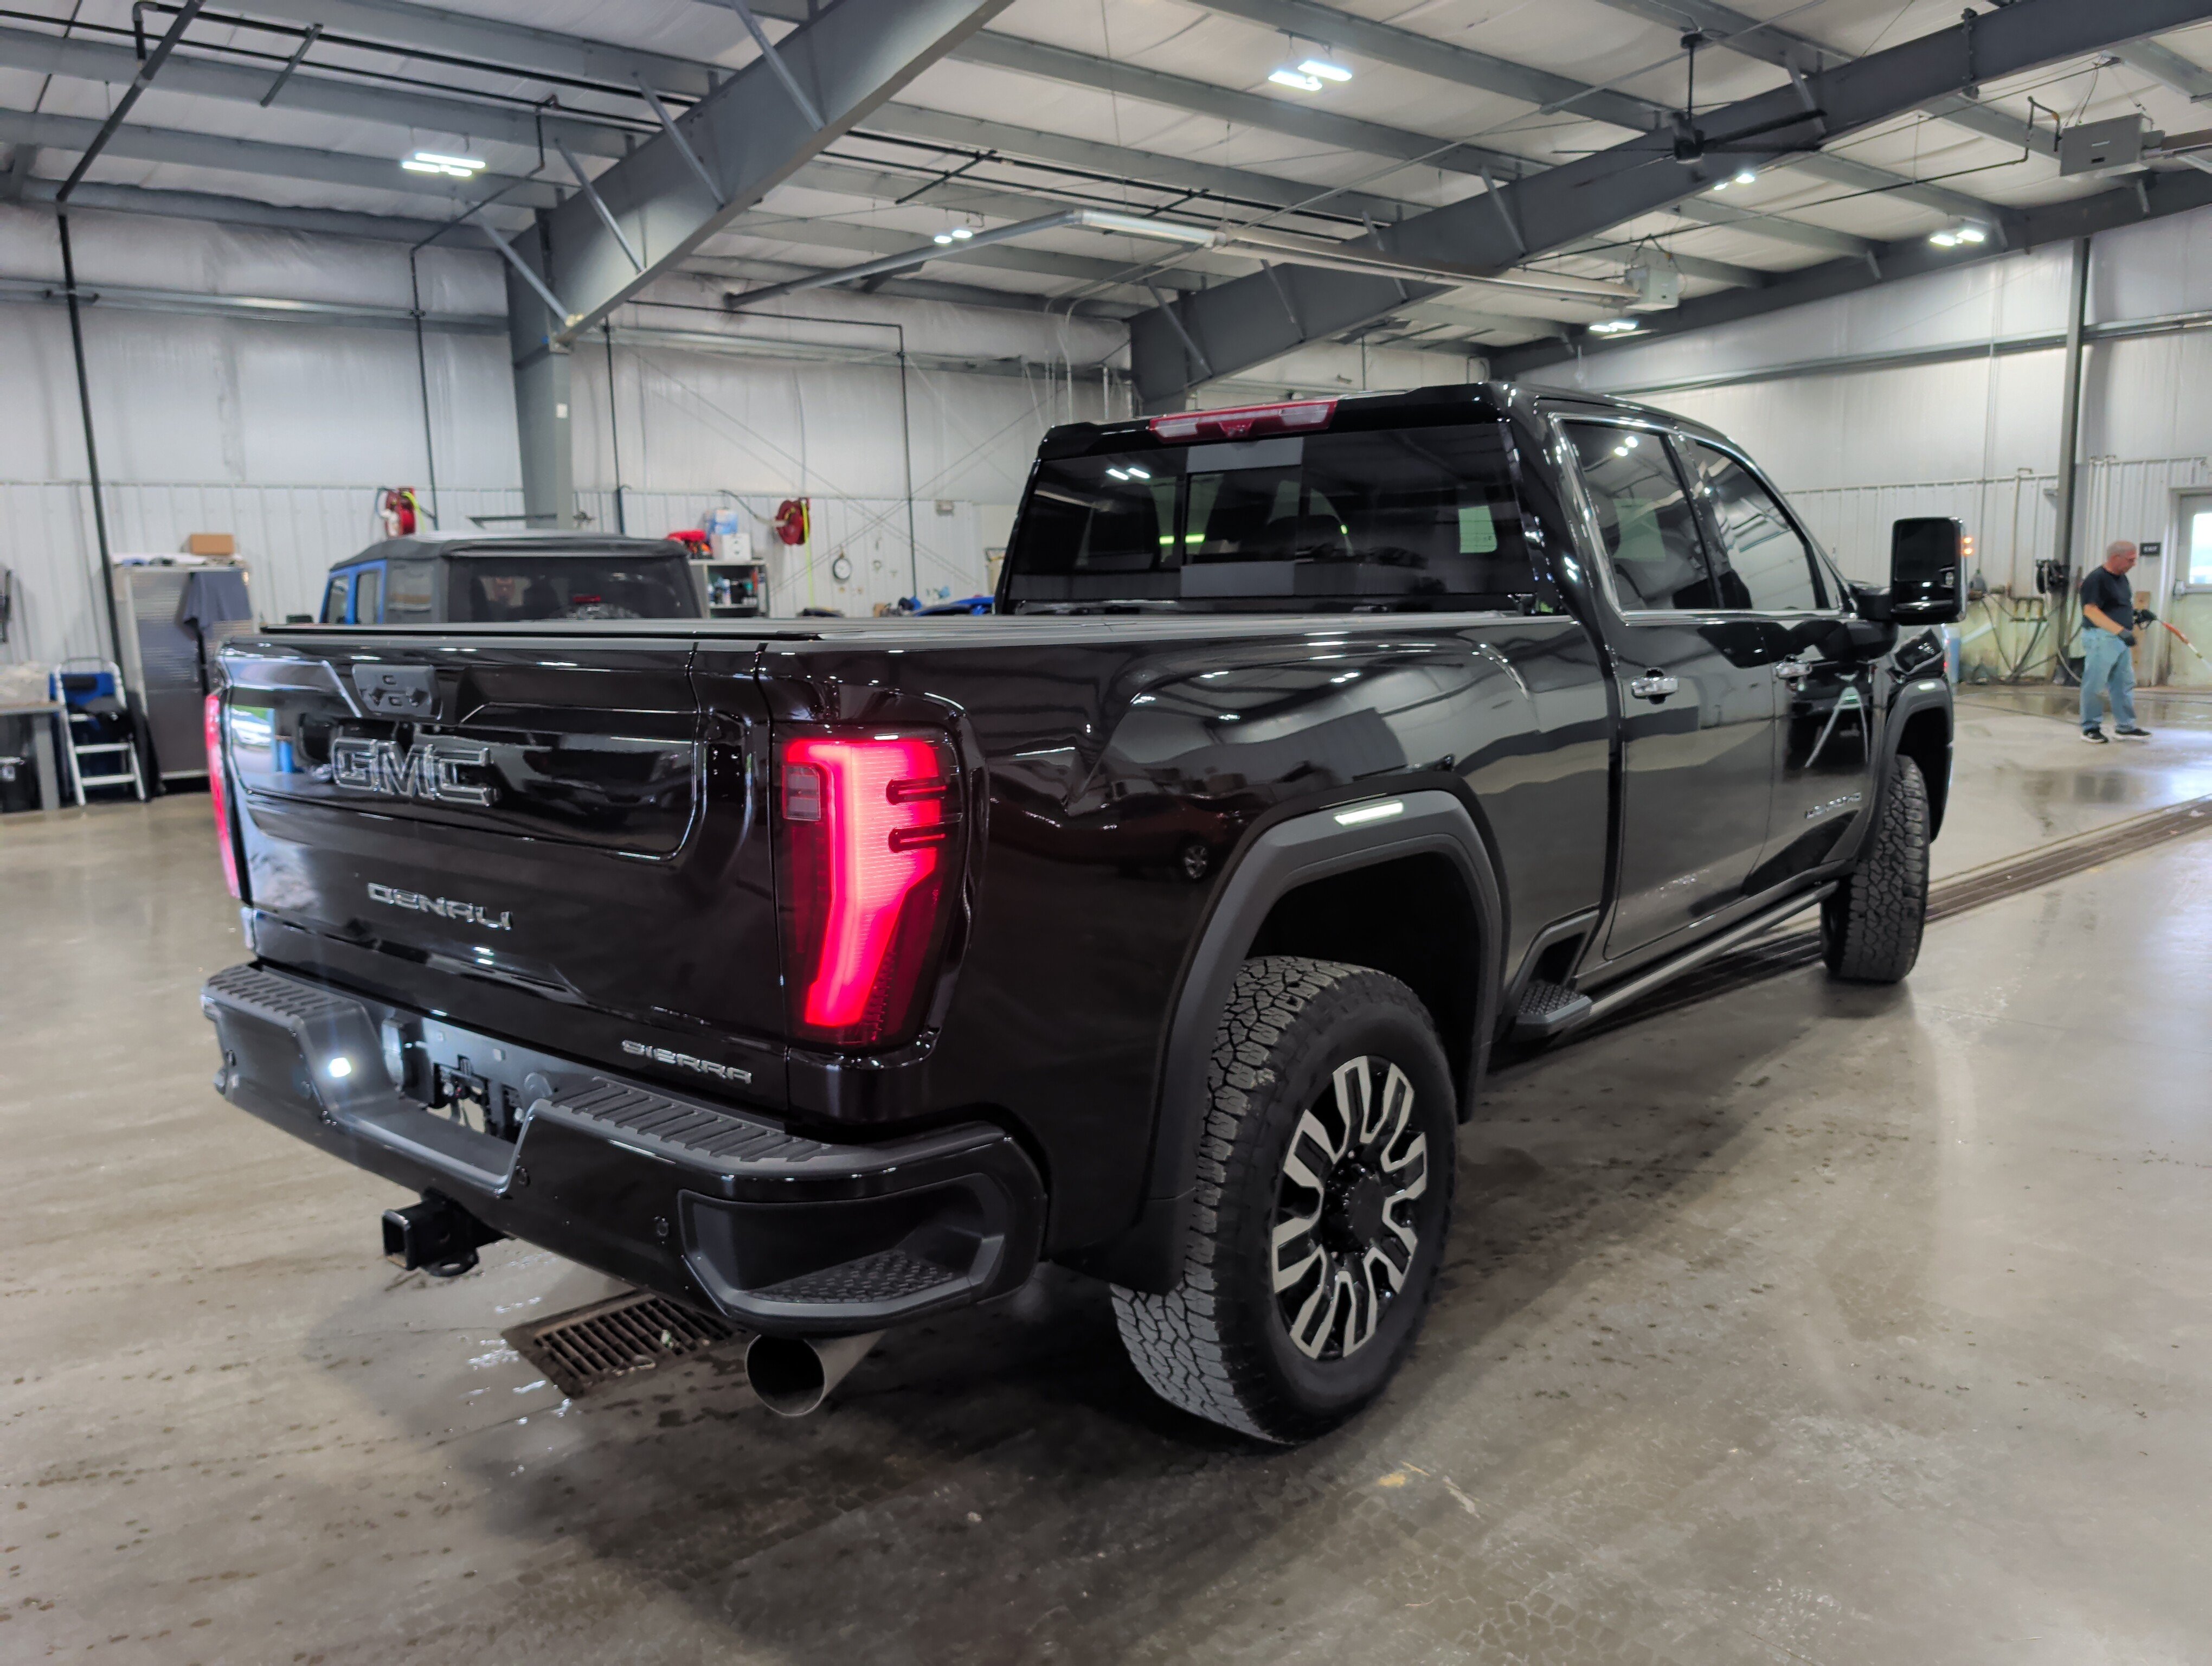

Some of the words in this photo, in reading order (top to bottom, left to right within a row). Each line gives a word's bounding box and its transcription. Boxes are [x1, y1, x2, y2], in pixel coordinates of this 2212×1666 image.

[331, 738, 492, 806] GMC
[367, 882, 512, 931] DENALI
[622, 1040, 753, 1084] SIERRA
